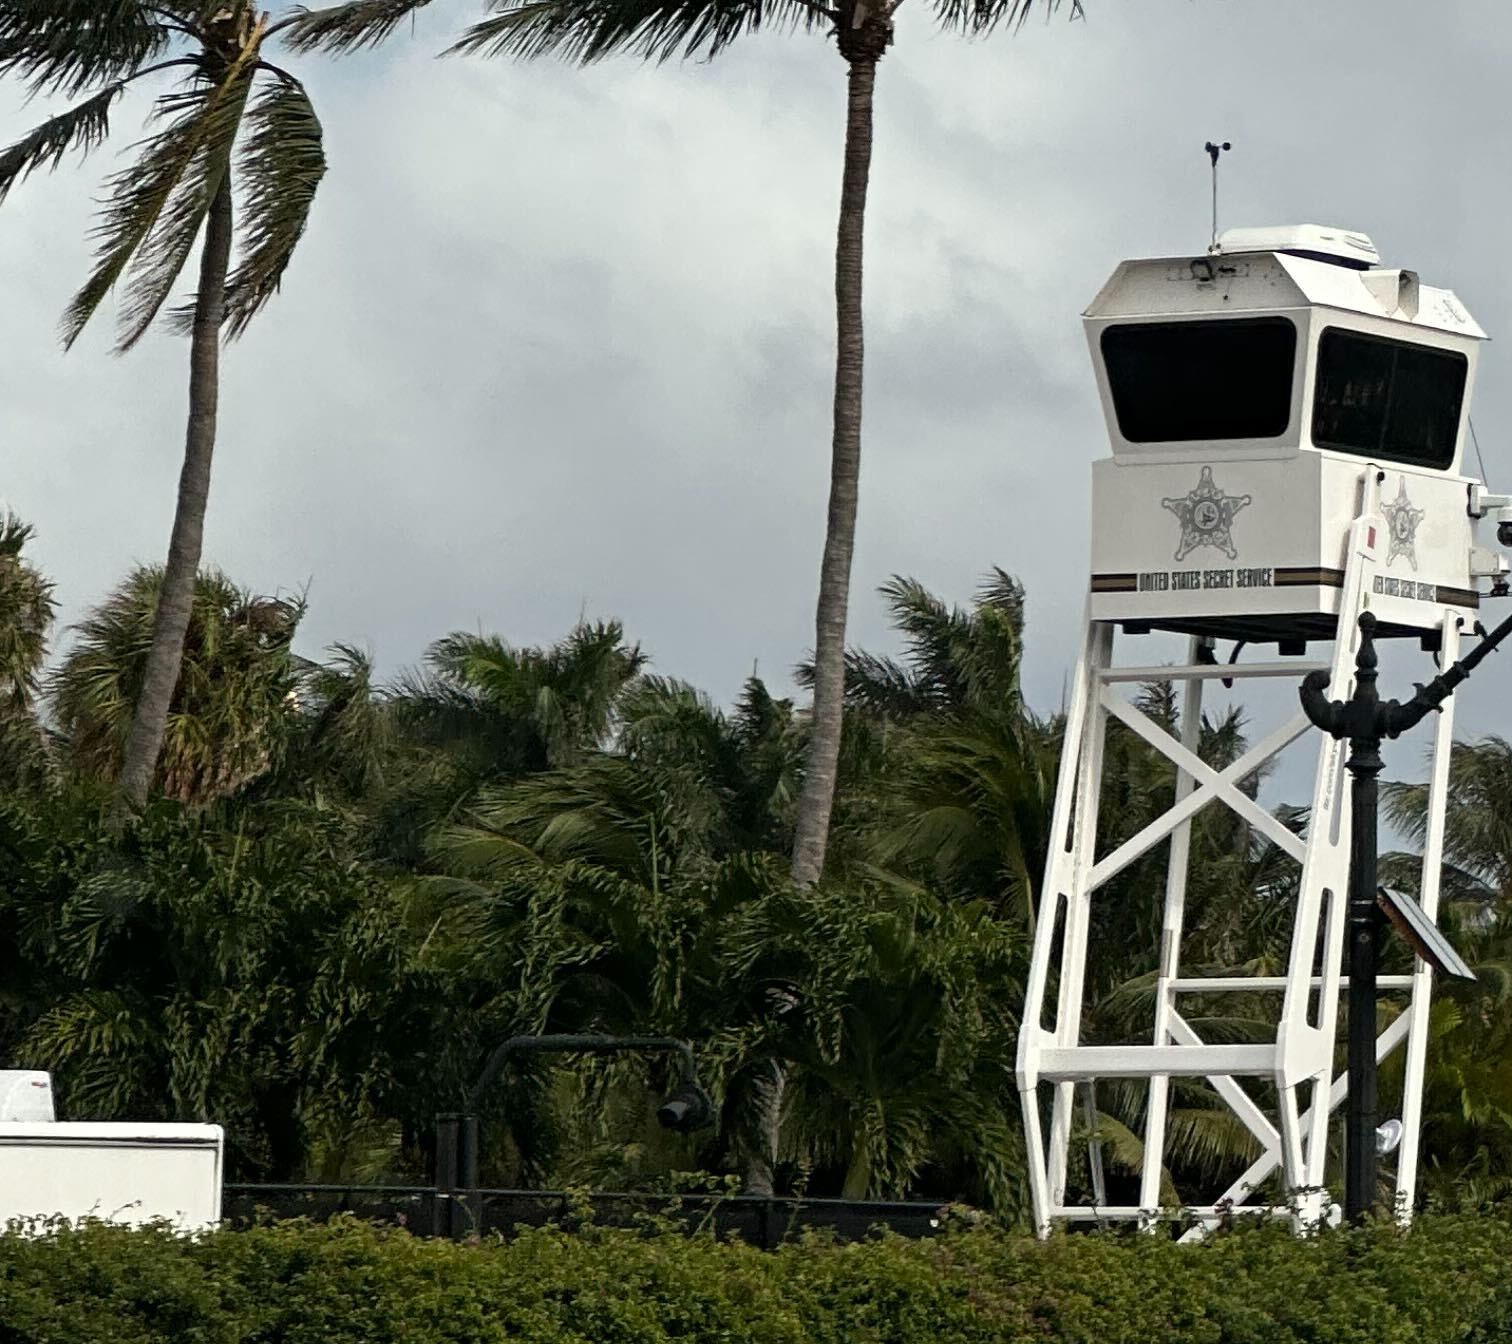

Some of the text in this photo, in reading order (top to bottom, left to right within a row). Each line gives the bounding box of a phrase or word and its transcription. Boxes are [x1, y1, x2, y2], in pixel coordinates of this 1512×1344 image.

[1171, 570, 1200, 591] STATES
[1203, 569, 1235, 589] SECRET
[1236, 568, 1272, 588] SERVICE
